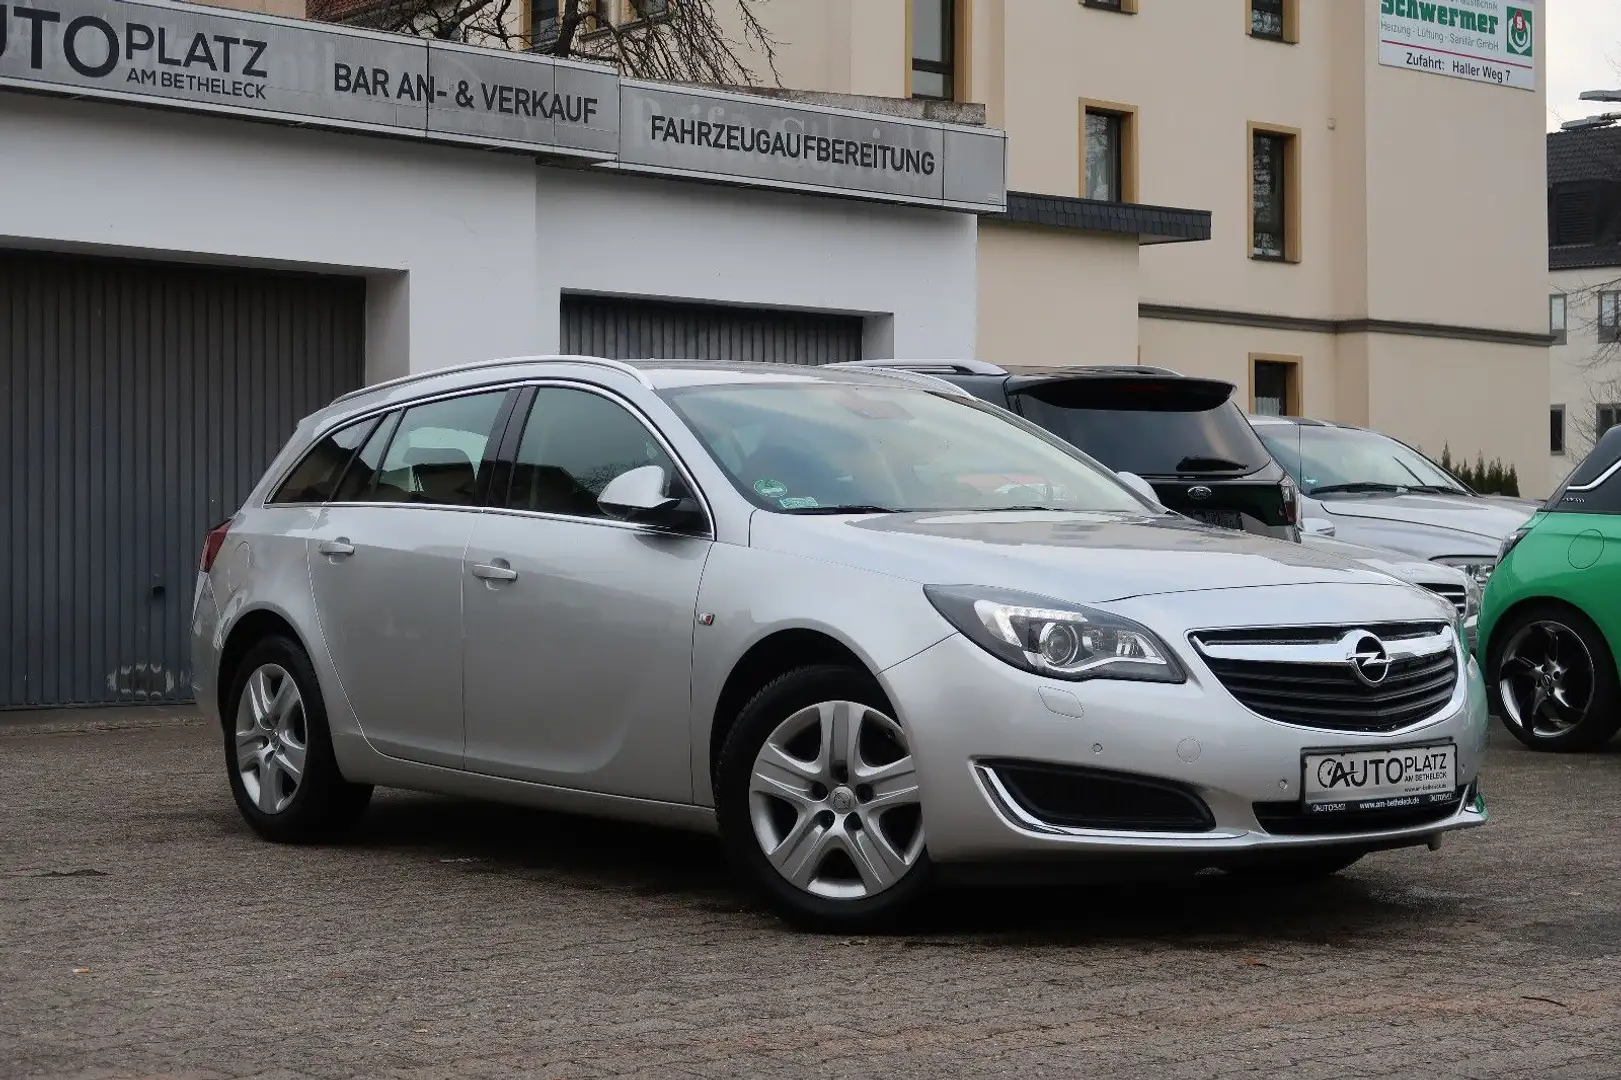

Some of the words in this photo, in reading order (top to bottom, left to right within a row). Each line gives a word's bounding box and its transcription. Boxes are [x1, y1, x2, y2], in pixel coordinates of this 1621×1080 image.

[0, 4, 268, 78] TOPLATZ
[1381, 20, 1412, 37] Heizung
[1417, 27, 1444, 44] Lüftung
[1449, 33, 1475, 47] Sanitär
[1476, 38, 1499, 51] GmbH
[1406, 52, 1445, 71] Zufahrt:
[1452, 60, 1480, 77] Haller
[1482, 66, 1503, 83] Weg
[1505, 70, 1511, 81] 7
[126, 68, 156, 86] AM
[161, 71, 267, 100] BETHELECK
[334, 62, 390, 98] BAR
[396, 71, 447, 104] AN-
[455, 79, 475, 109] &
[481, 82, 598, 124] VERKAUF
[650, 114, 935, 176] FAHRZEUGAUFBEREITUNG
[1404, 775, 1414, 783] AM
[1415, 771, 1447, 782] BETHELECK
